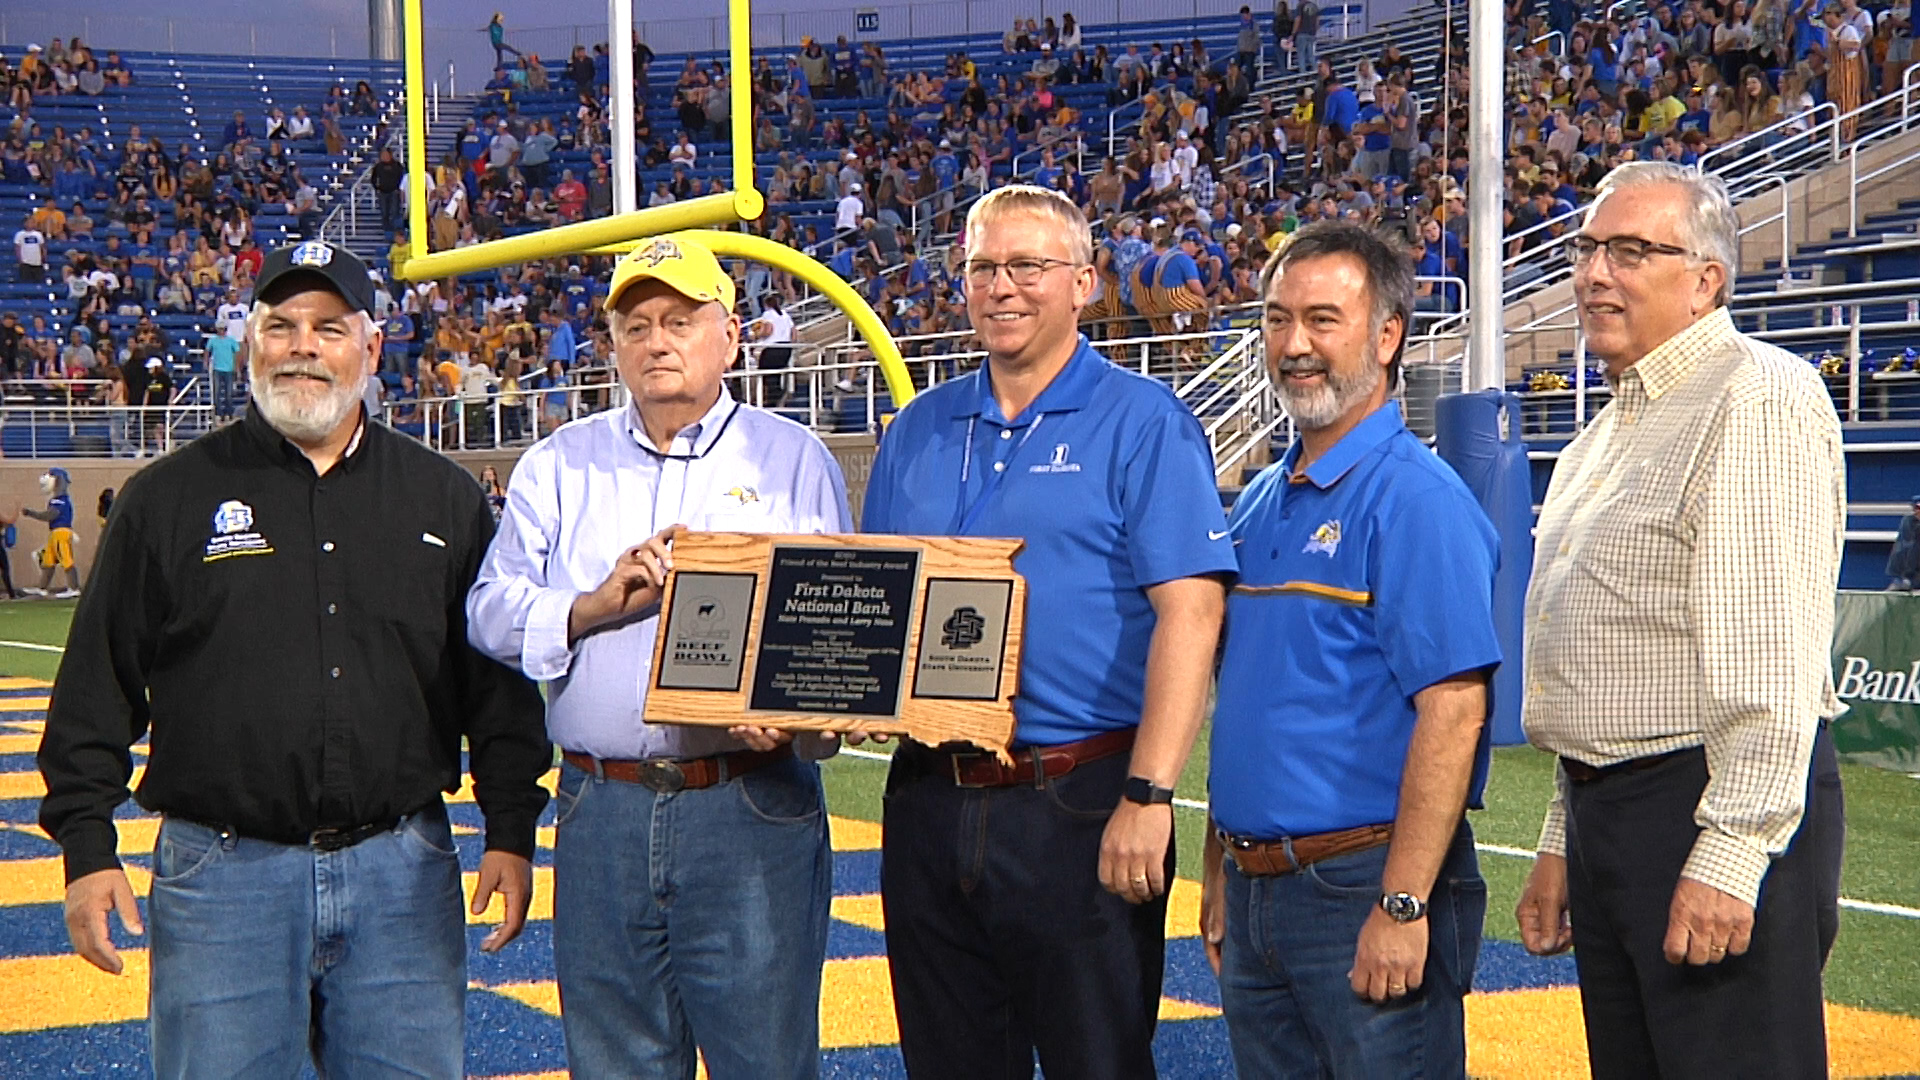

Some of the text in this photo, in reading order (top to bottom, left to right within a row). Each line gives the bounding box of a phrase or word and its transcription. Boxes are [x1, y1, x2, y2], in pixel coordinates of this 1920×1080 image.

[794, 582, 886, 598] First Dakota
[784, 598, 892, 615] National Bank
[675, 642, 725, 651] BEEF
[673, 651, 733, 662] BOWL
[1837, 656, 1920, 704] Bank
